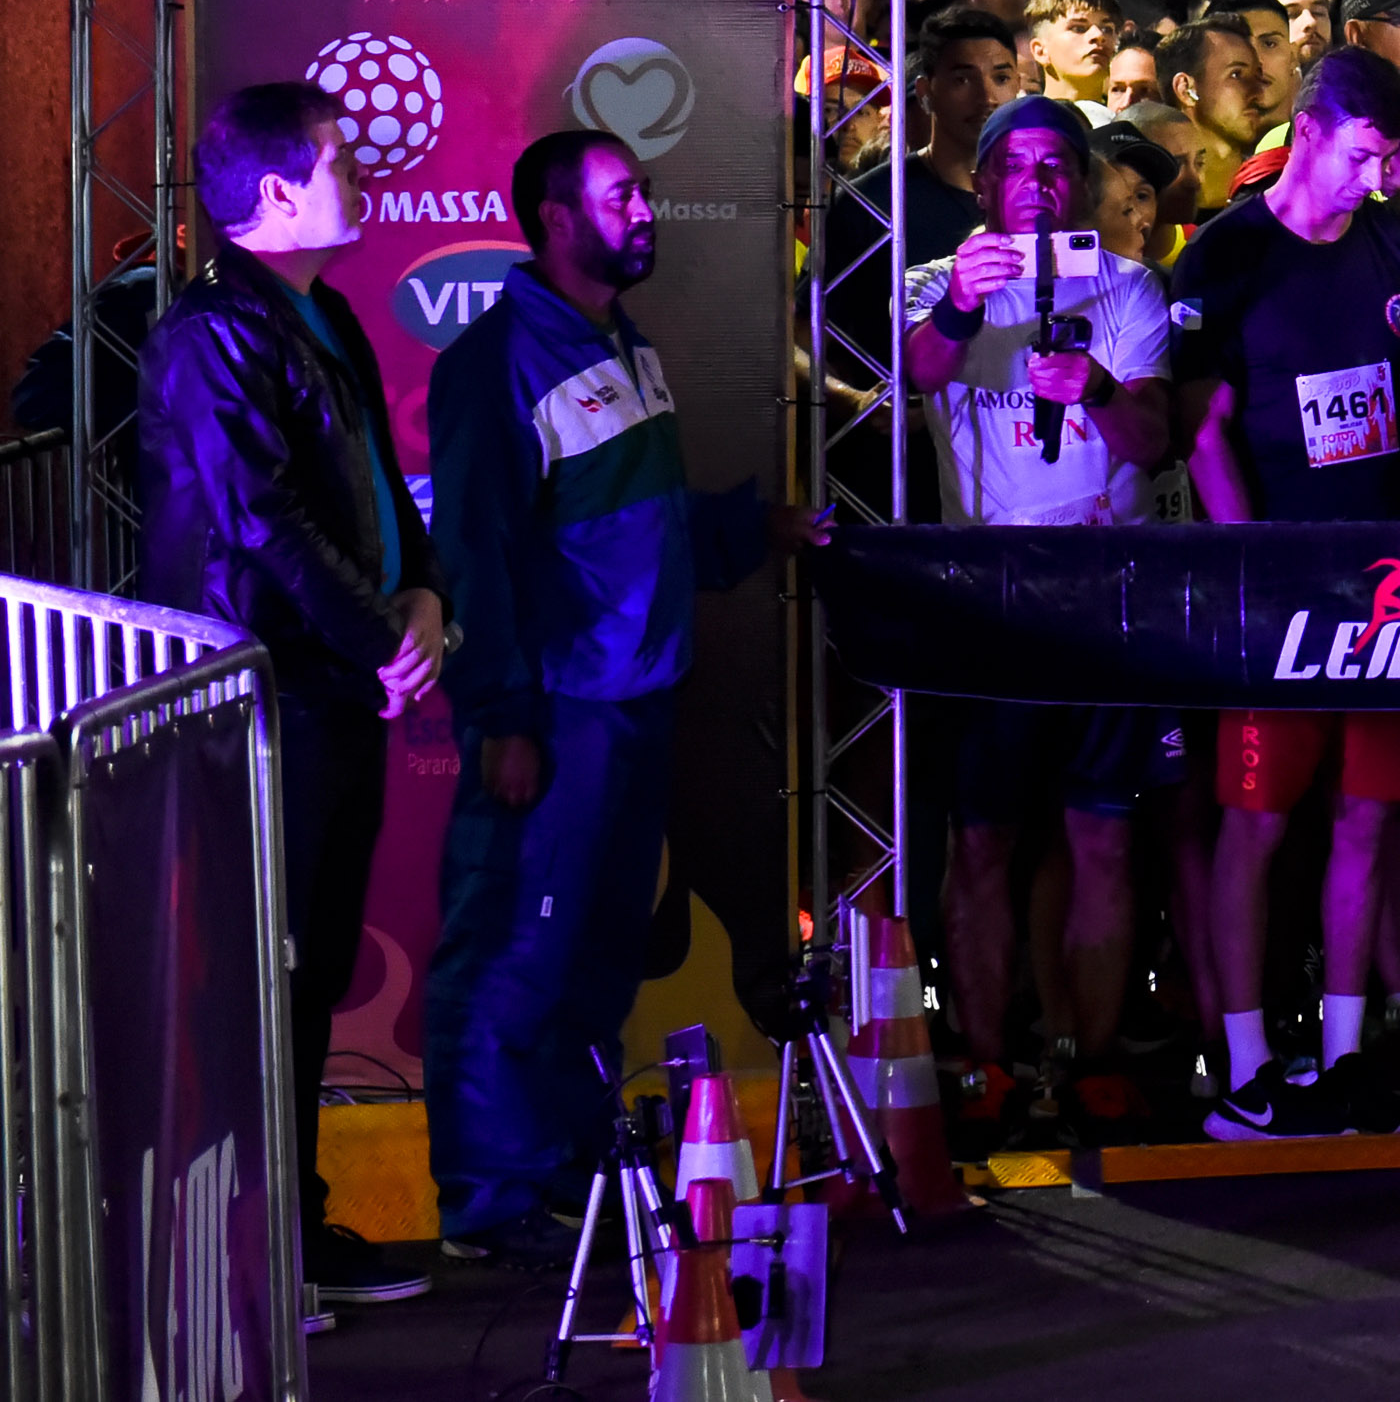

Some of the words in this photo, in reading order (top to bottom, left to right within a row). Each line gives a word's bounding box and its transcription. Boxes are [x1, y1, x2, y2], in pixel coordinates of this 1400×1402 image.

[379, 191, 508, 223] MASSA
[648, 198, 738, 221] Massa
[407, 278, 505, 325] VIT
[1302, 386, 1387, 426] 1461
[1013, 417, 1088, 447] RN
